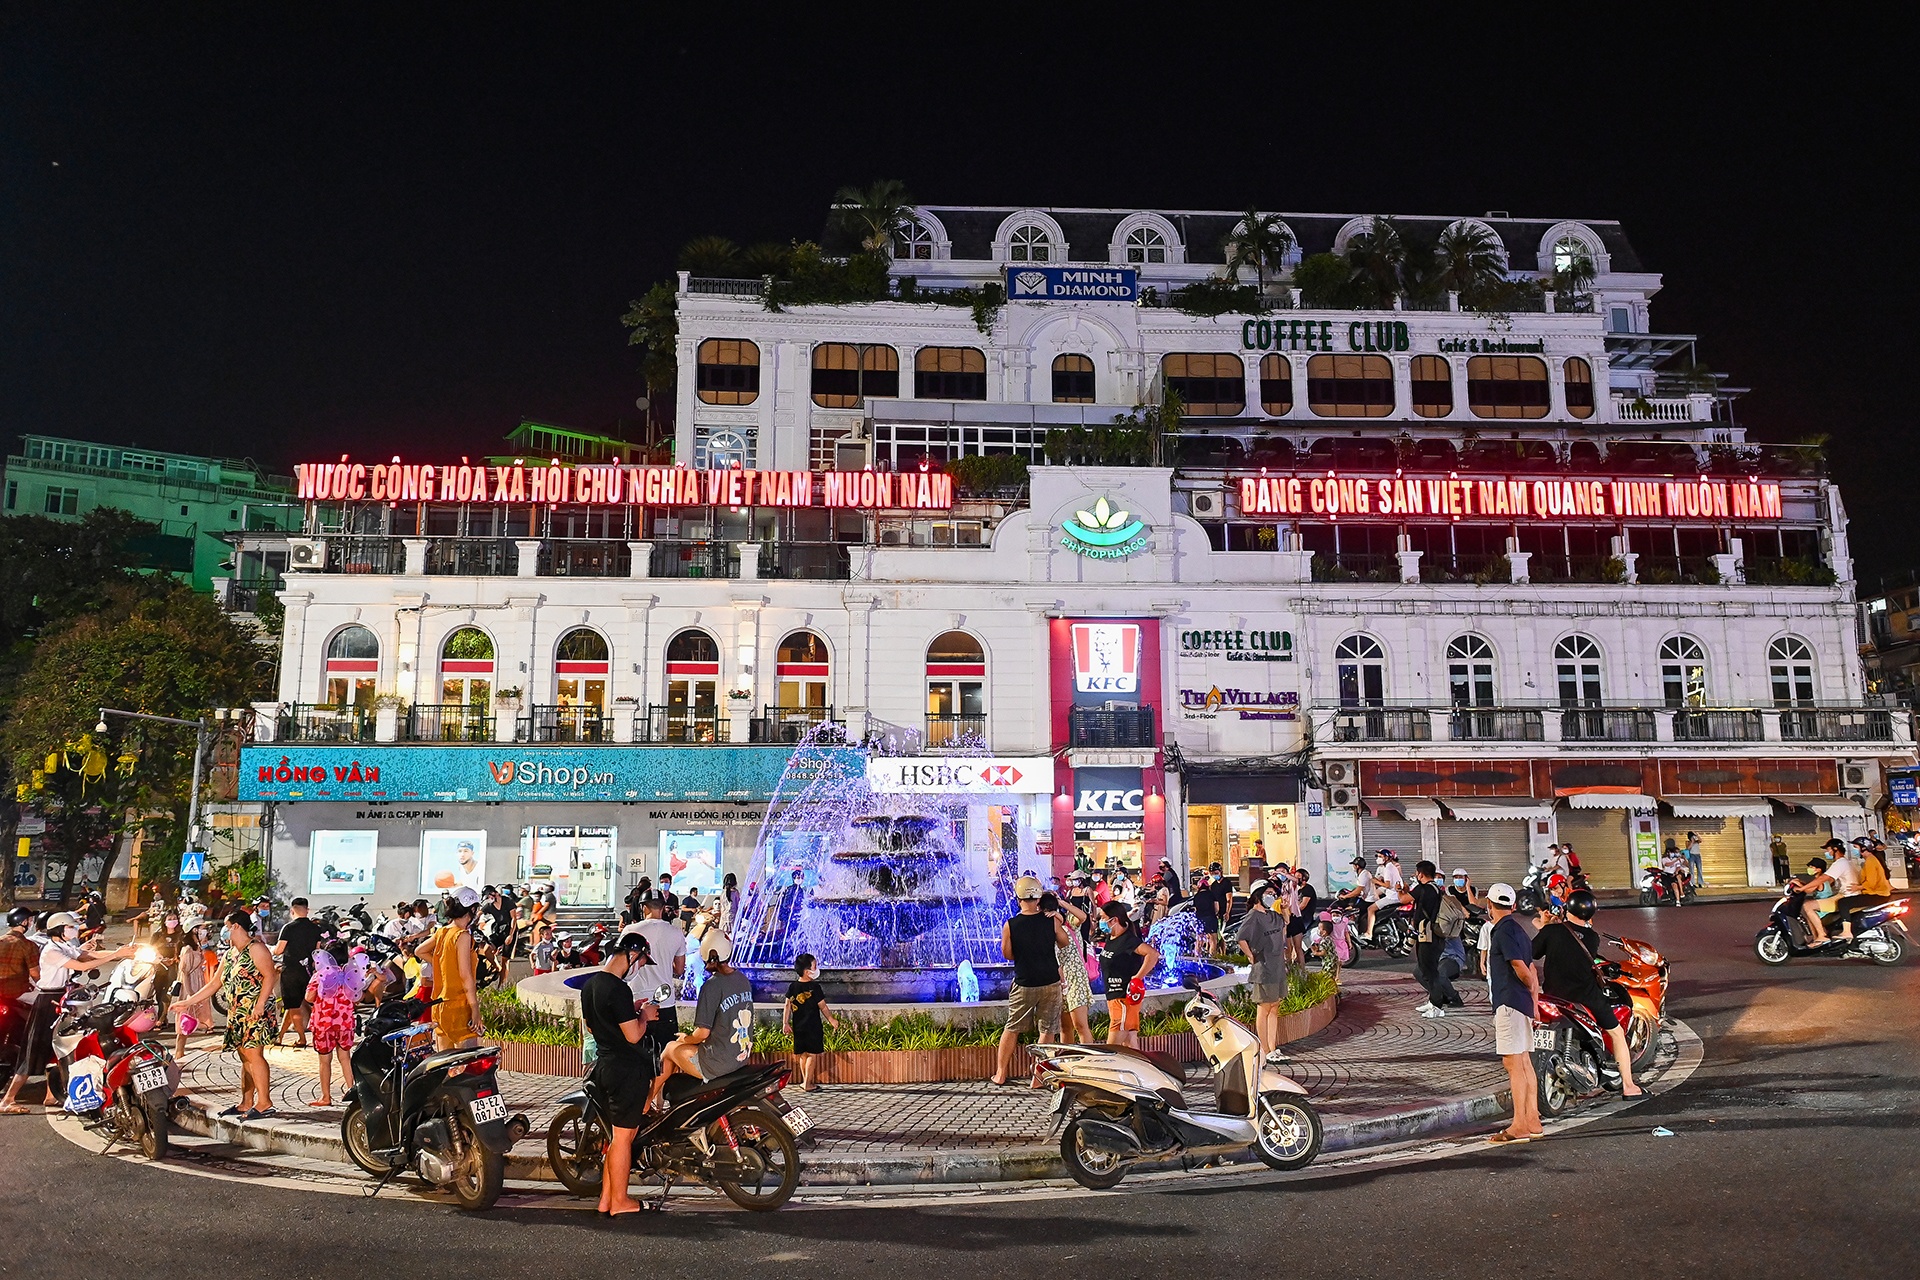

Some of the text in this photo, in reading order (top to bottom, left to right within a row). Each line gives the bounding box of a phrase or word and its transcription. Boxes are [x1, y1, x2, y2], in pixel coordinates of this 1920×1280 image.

[1062, 272, 1123, 283] MINH
[1053, 285, 1131, 297] DIAMOND
[1242, 320, 1410, 351] COFFEE CLUB
[297, 454, 952, 513] NƯỚC CỘNG HÒA XÃ HỘI CHỦ NGHĨA VIỆT NAM MUÔN NĂM
[1241, 466, 1782, 521] ĐẢNG CỘNG SẢN VIỆT NAM QUANG VINH MUÔN NĂM
[1060, 536, 1147, 559] PHYTOPHARCO
[1181, 630, 1293, 651] COFFEE CLUB
[1086, 677, 1128, 690] KFC
[258, 755, 380, 783] HỒNG VÂN
[900, 765, 973, 787] HSBC
[1076, 790, 1144, 812] KFC
[1309, 803, 1321, 813] 3B
[356, 807, 365, 818] IN
[422, 804, 444, 818] HÌNH
[649, 810, 668, 819] MÁY
[540, 827, 573, 836] SONY
[1105, 821, 1142, 831] Kentucky
[630, 858, 642, 866] 3B
[140, 1076, 165, 1091] 2862
[474, 1105, 506, 1123] 087.49
